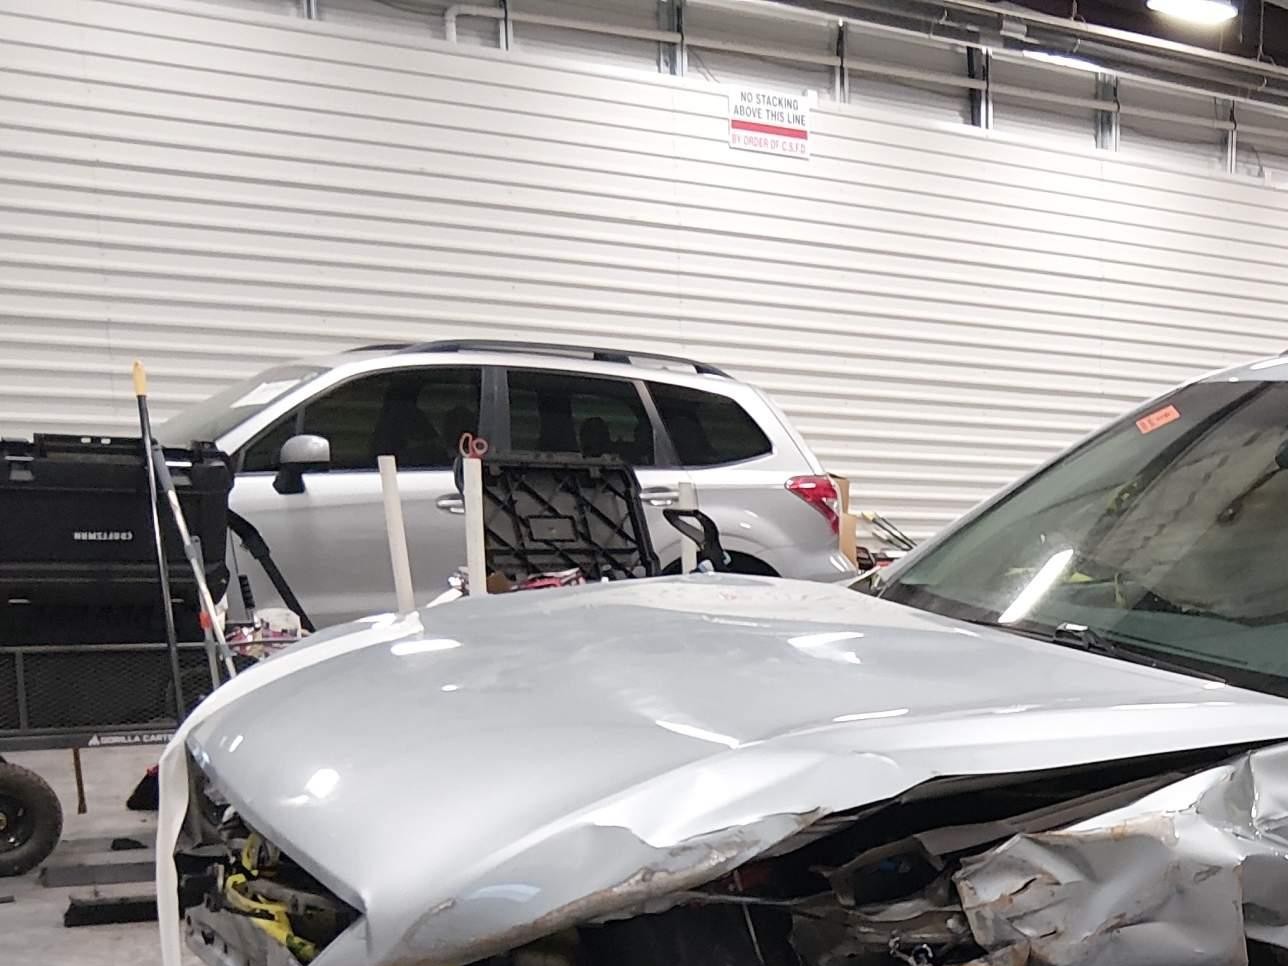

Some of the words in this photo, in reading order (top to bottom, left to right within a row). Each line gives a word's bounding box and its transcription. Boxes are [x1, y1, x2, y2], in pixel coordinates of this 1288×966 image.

[741, 91, 753, 103] NO
[755, 93, 799, 111] STACKING
[733, 104, 762, 119] ABOVE
[765, 109, 785, 122] THIS
[787, 112, 806, 126] LINE
[732, 134, 742, 144] BY
[743, 136, 769, 149] ORDER
[770, 139, 780, 150] OF
